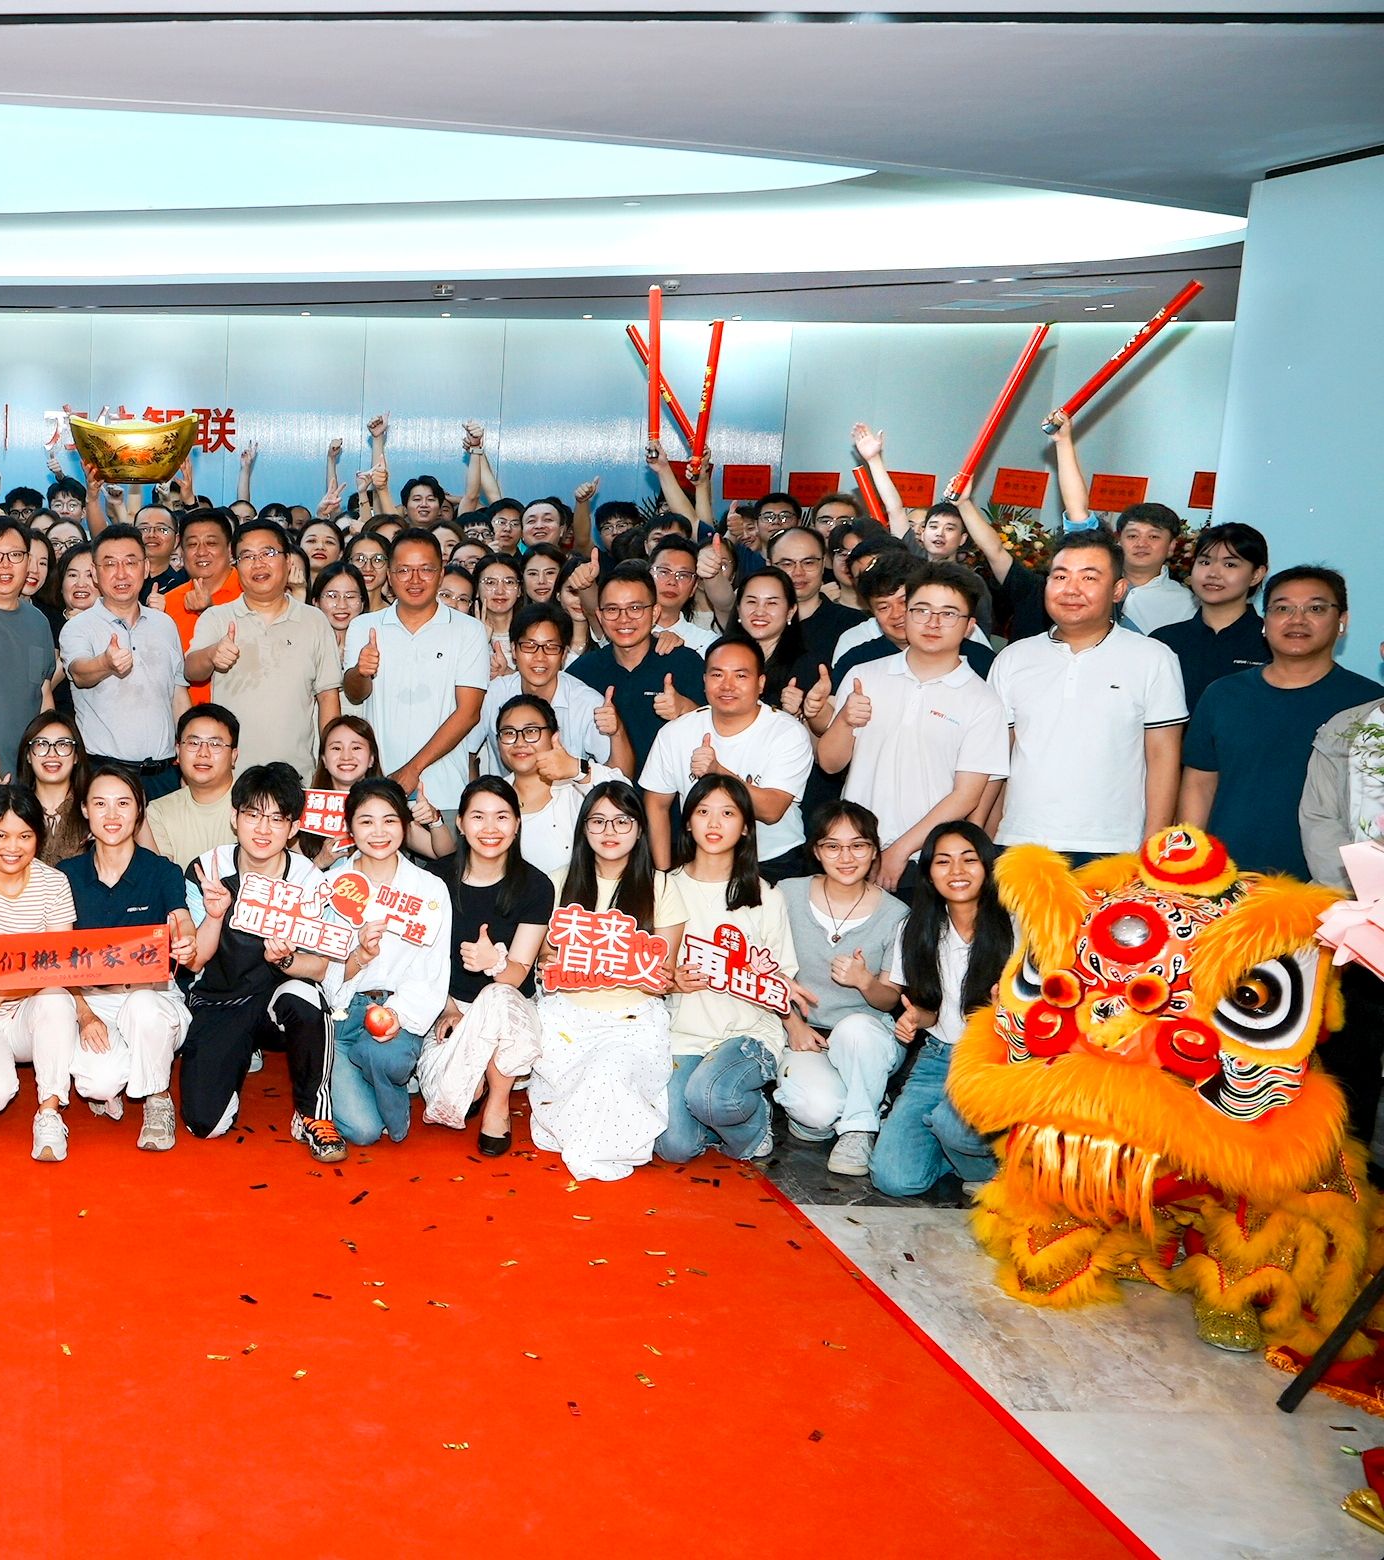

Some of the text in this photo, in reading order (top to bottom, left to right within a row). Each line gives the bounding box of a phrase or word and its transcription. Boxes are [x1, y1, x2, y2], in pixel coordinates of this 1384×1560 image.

[44, 404, 236, 453] 方联
[304, 812, 347, 832] 再创
[241, 875, 304, 911] 美好
[376, 885, 423, 915] 财源
[232, 901, 353, 957] 如约而至
[385, 913, 427, 944] 广进
[554, 910, 631, 950] 未来
[720, 927, 741, 940] 乔迁
[720, 937, 741, 952] 大吉
[631, 938, 663, 954] The
[563, 942, 663, 984] 自定义
[685, 934, 788, 1012] 再出发
